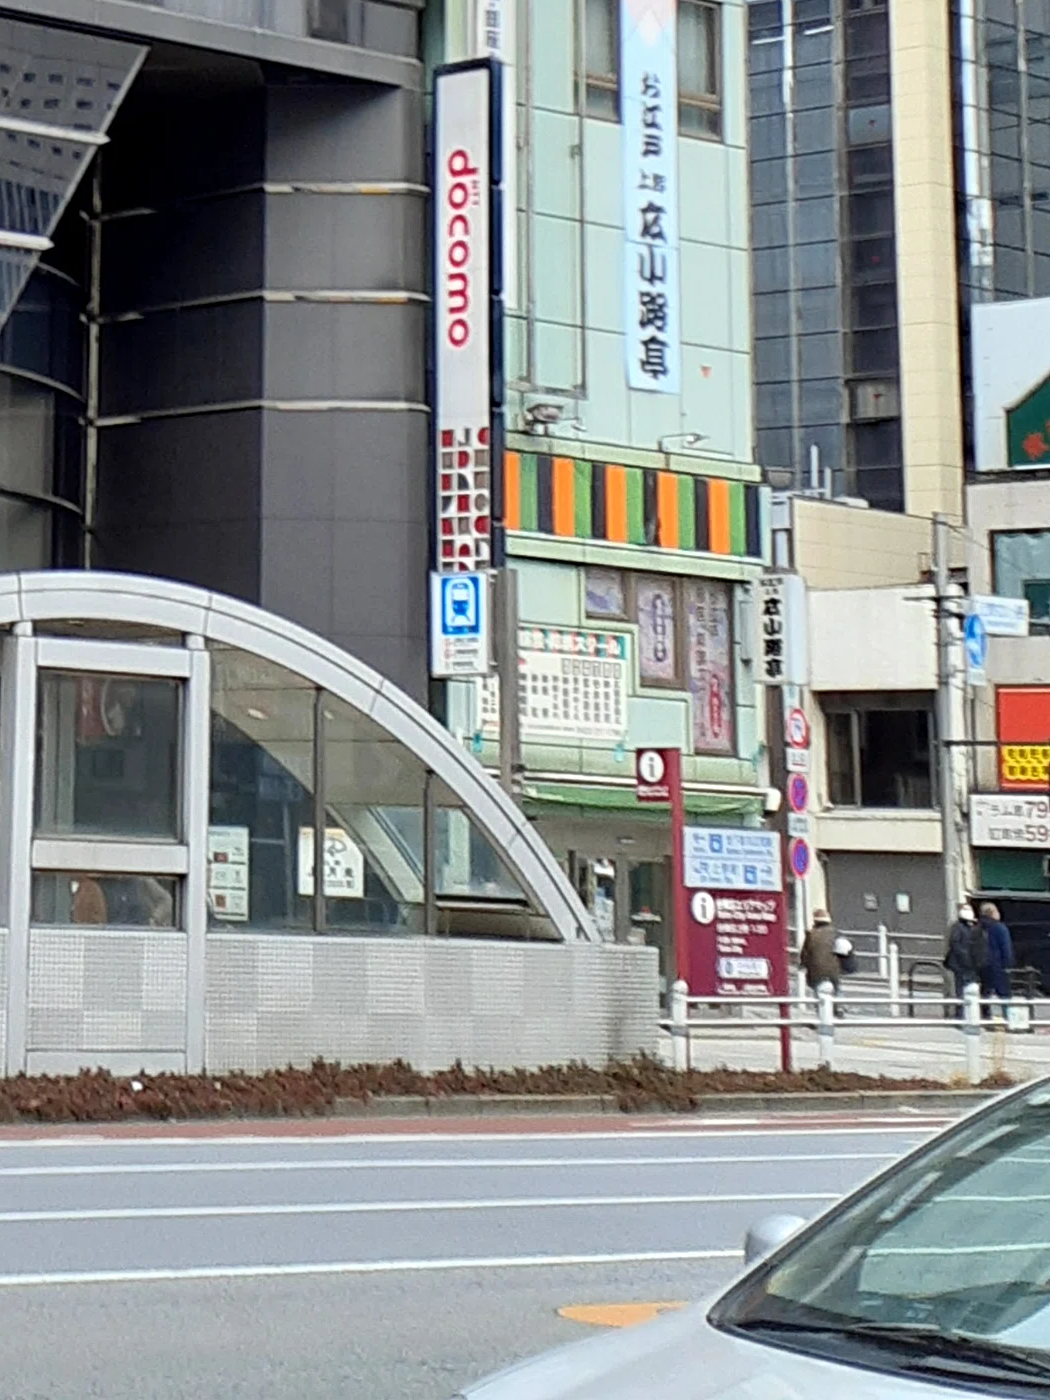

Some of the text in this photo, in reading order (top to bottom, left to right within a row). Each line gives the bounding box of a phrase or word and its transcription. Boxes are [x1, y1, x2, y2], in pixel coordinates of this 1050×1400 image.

[448, 149, 477, 347] docomo
[638, 199, 670, 381] 広小路亭
